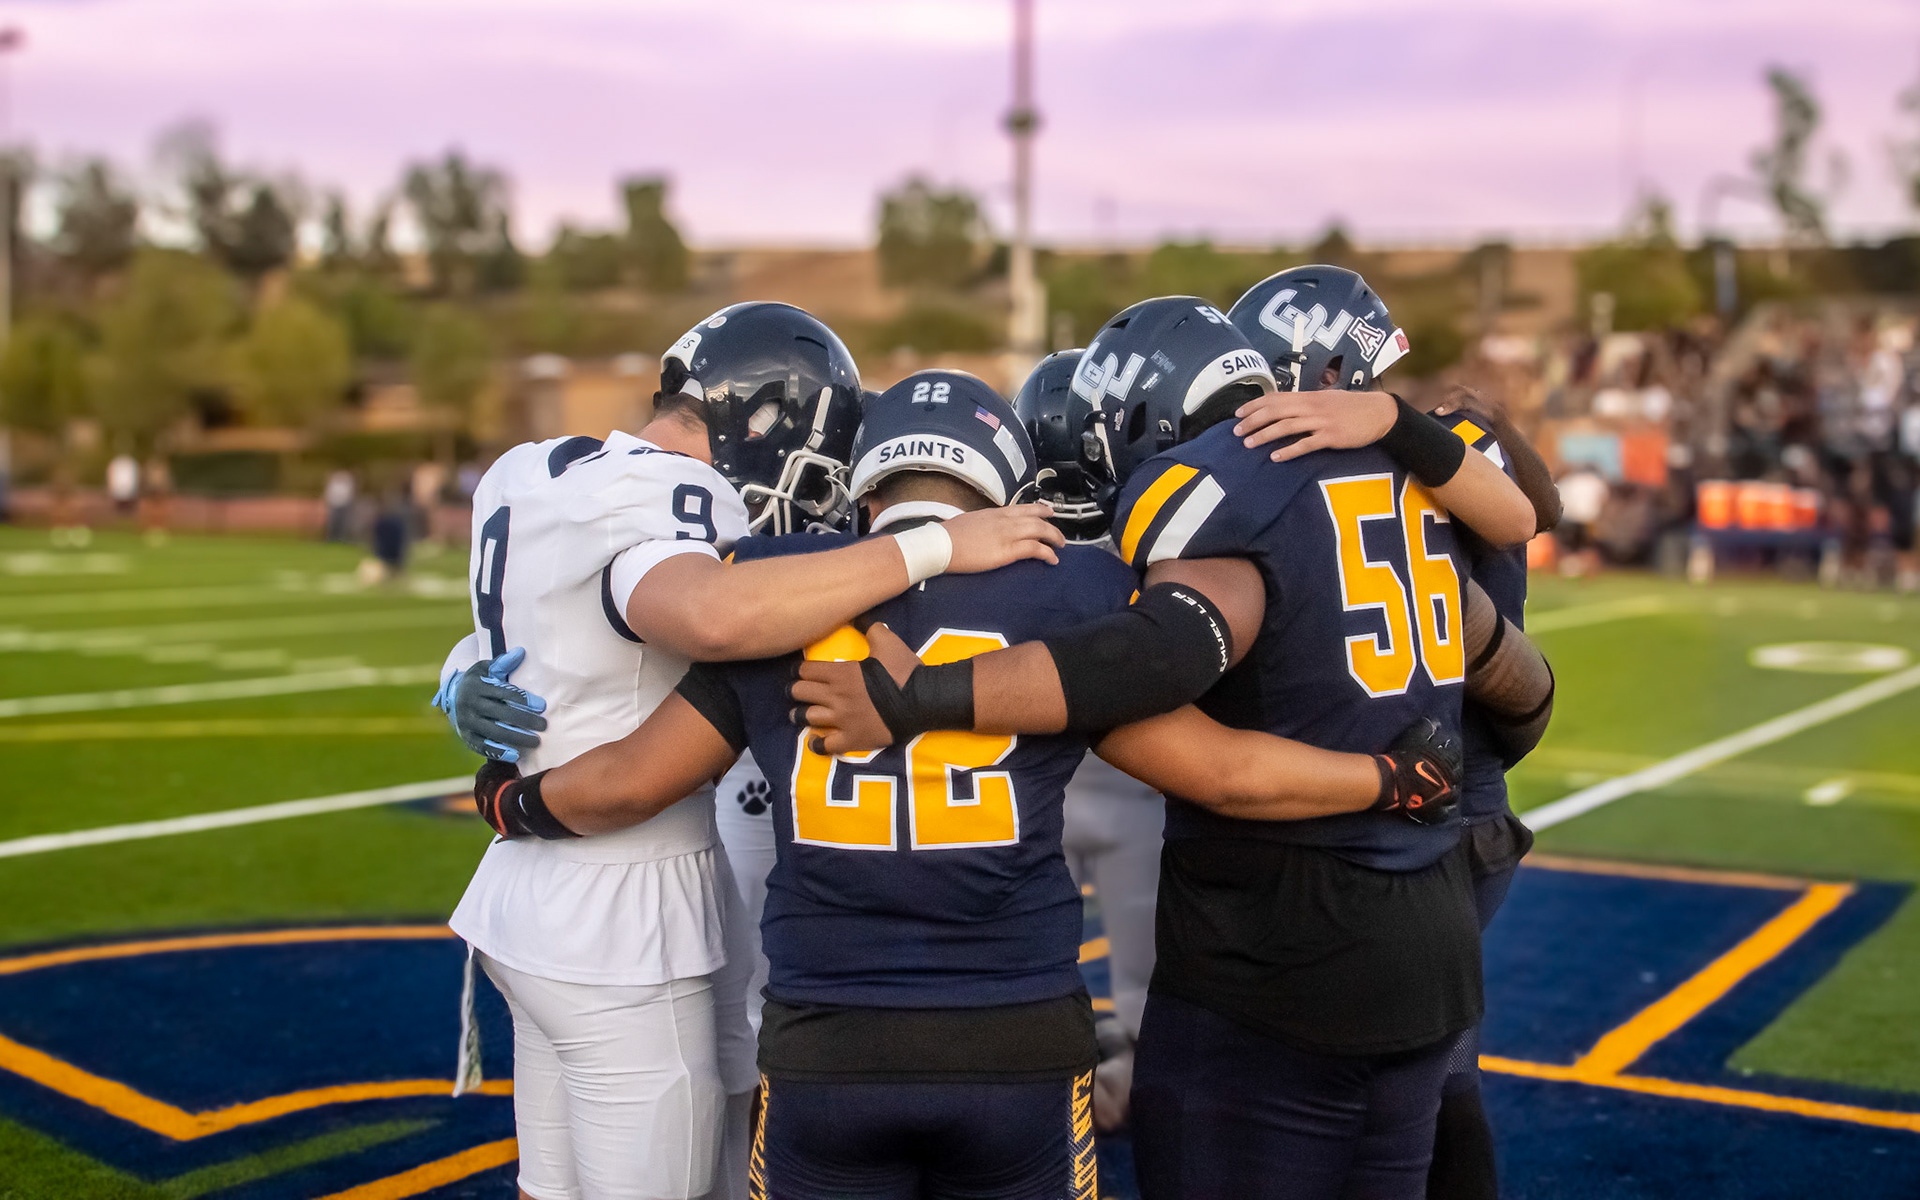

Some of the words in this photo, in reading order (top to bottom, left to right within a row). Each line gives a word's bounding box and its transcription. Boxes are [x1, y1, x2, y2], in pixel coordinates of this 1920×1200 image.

[1347, 316, 1387, 363] A
[911, 381, 952, 404] 22
[879, 440, 965, 464] SAINTS
[672, 482, 718, 544] 9
[476, 505, 511, 660] 9
[1318, 472, 1465, 699] 56
[791, 625, 1020, 851] 22
[1072, 1069, 1094, 1143] EAN
[1074, 1136, 1099, 1200] LUT
